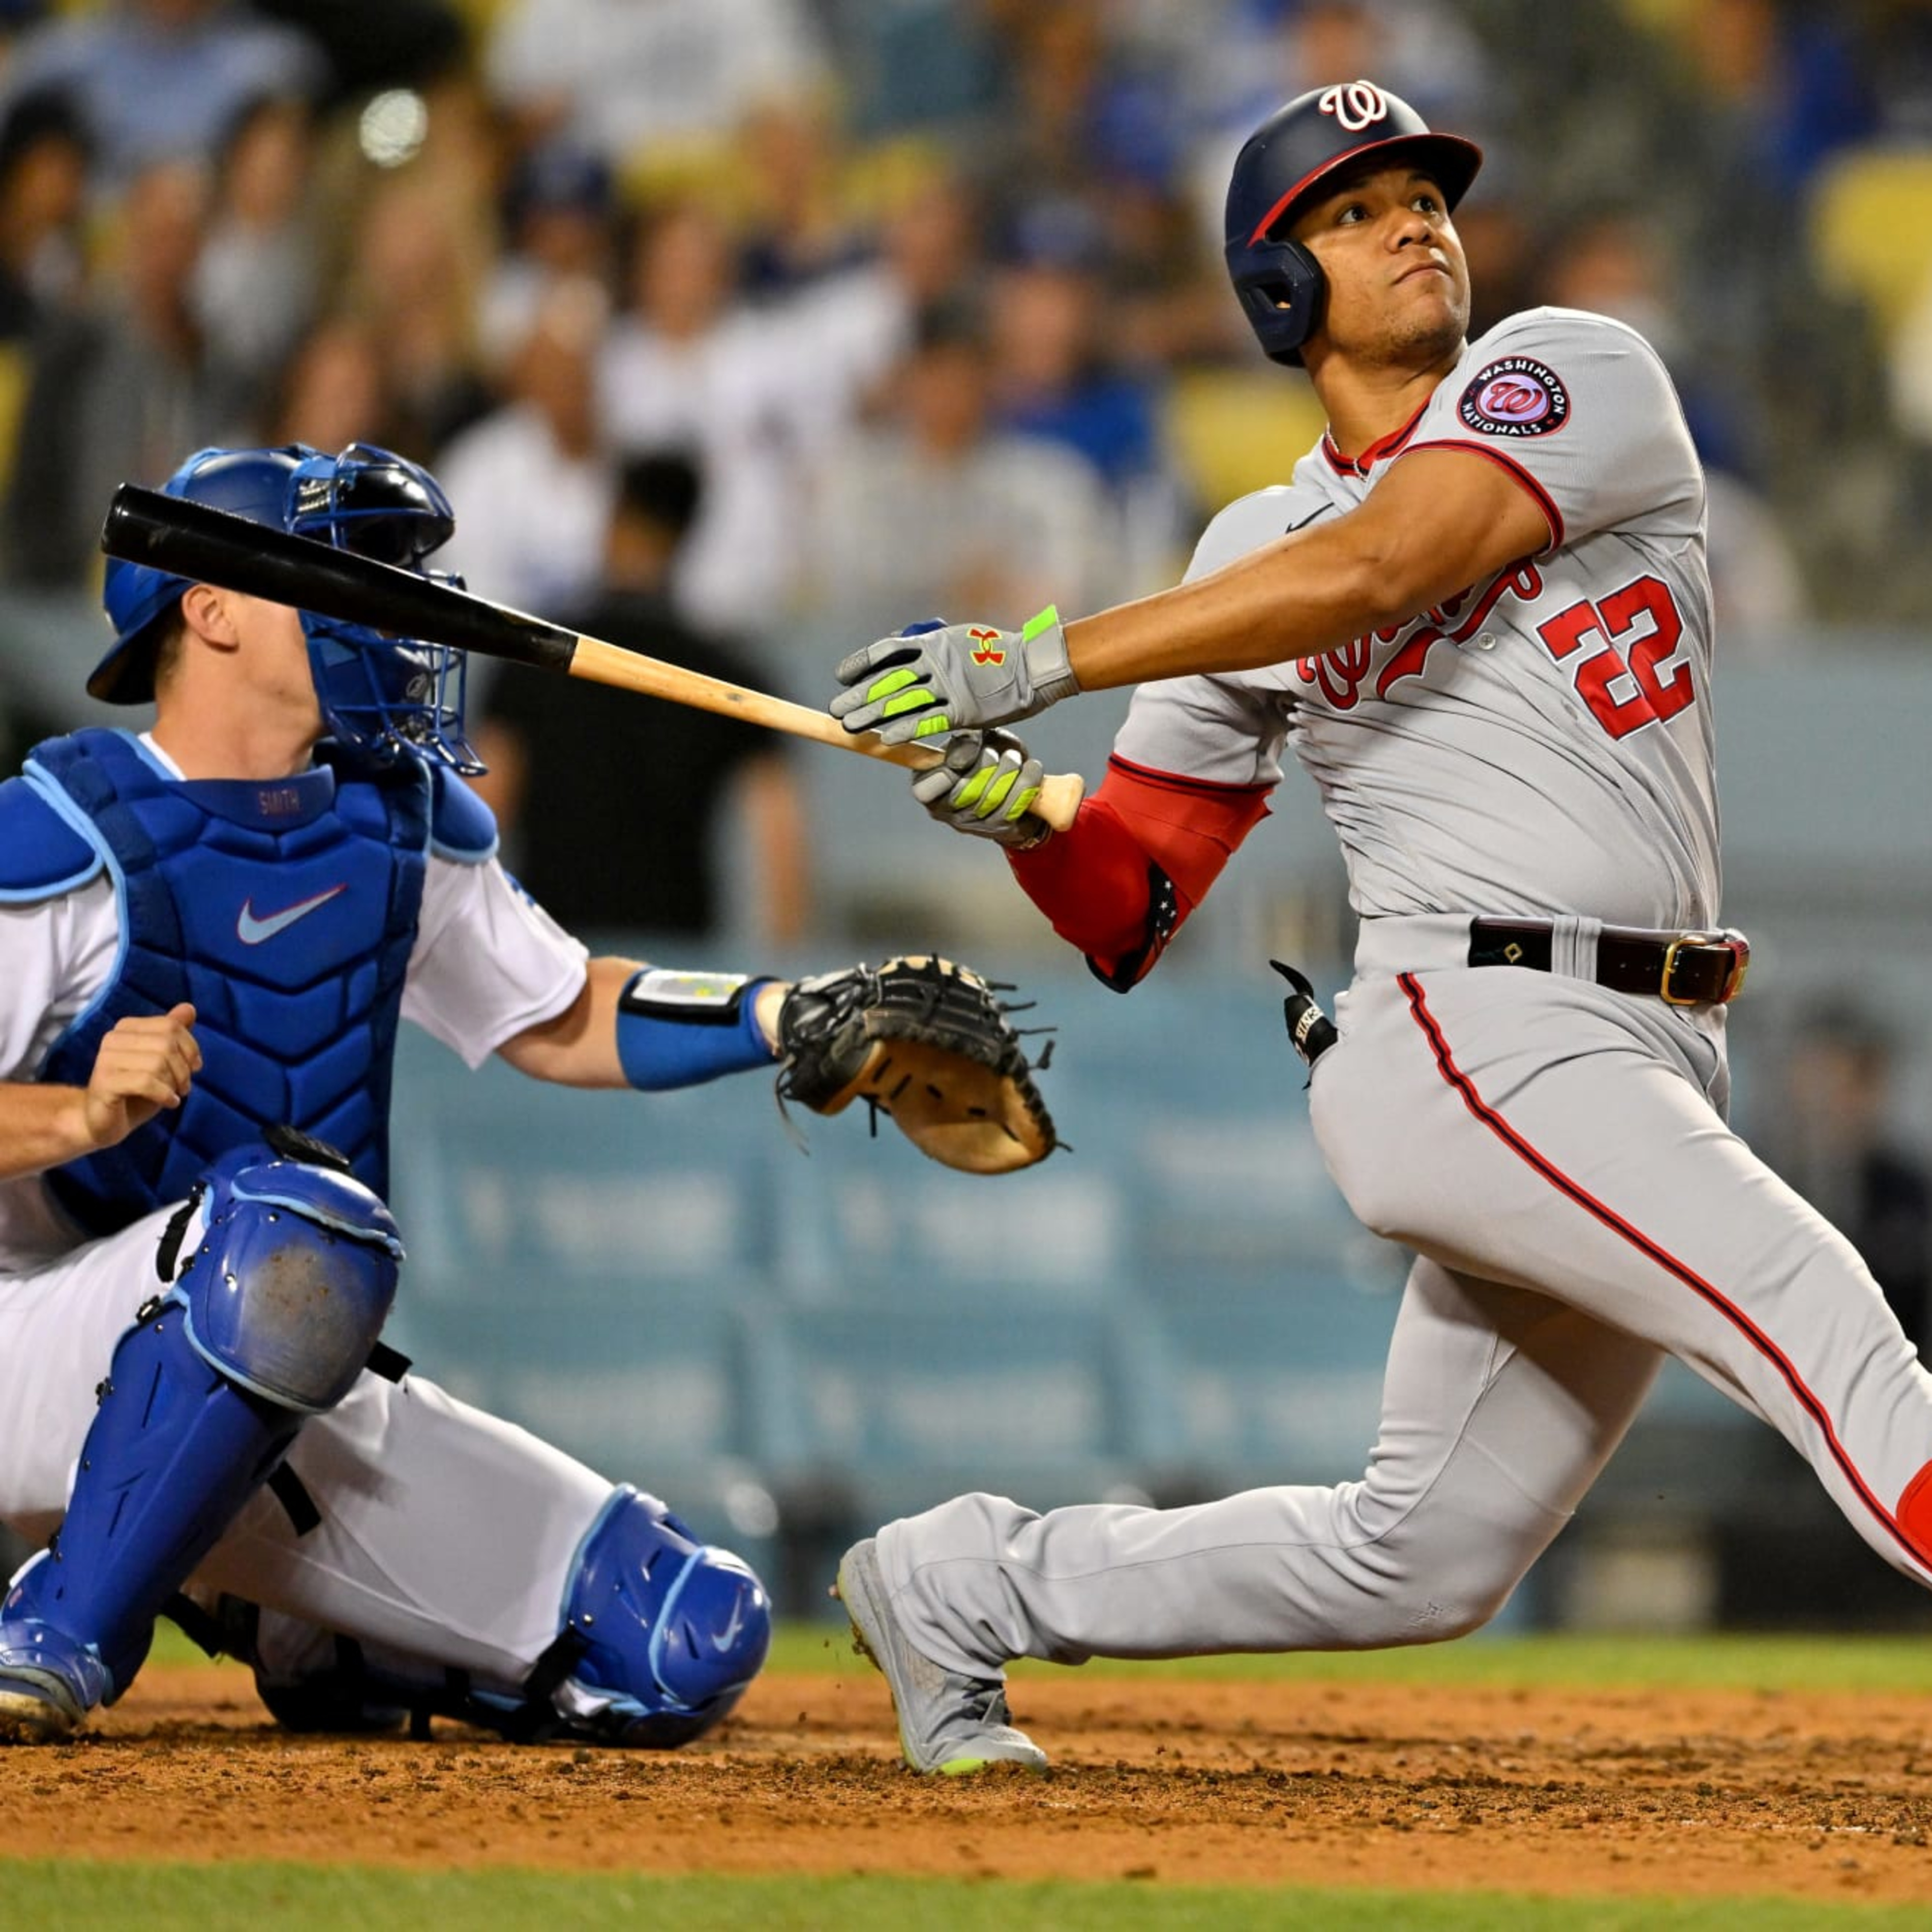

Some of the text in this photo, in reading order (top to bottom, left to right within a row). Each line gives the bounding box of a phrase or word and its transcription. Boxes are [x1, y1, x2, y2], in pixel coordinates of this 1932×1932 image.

[1319, 80, 1387, 132] W
[1478, 359, 1566, 415] WASHINGTON
[1461, 402, 1542, 435] NATIONALS
[1536, 572, 1696, 741] 22
